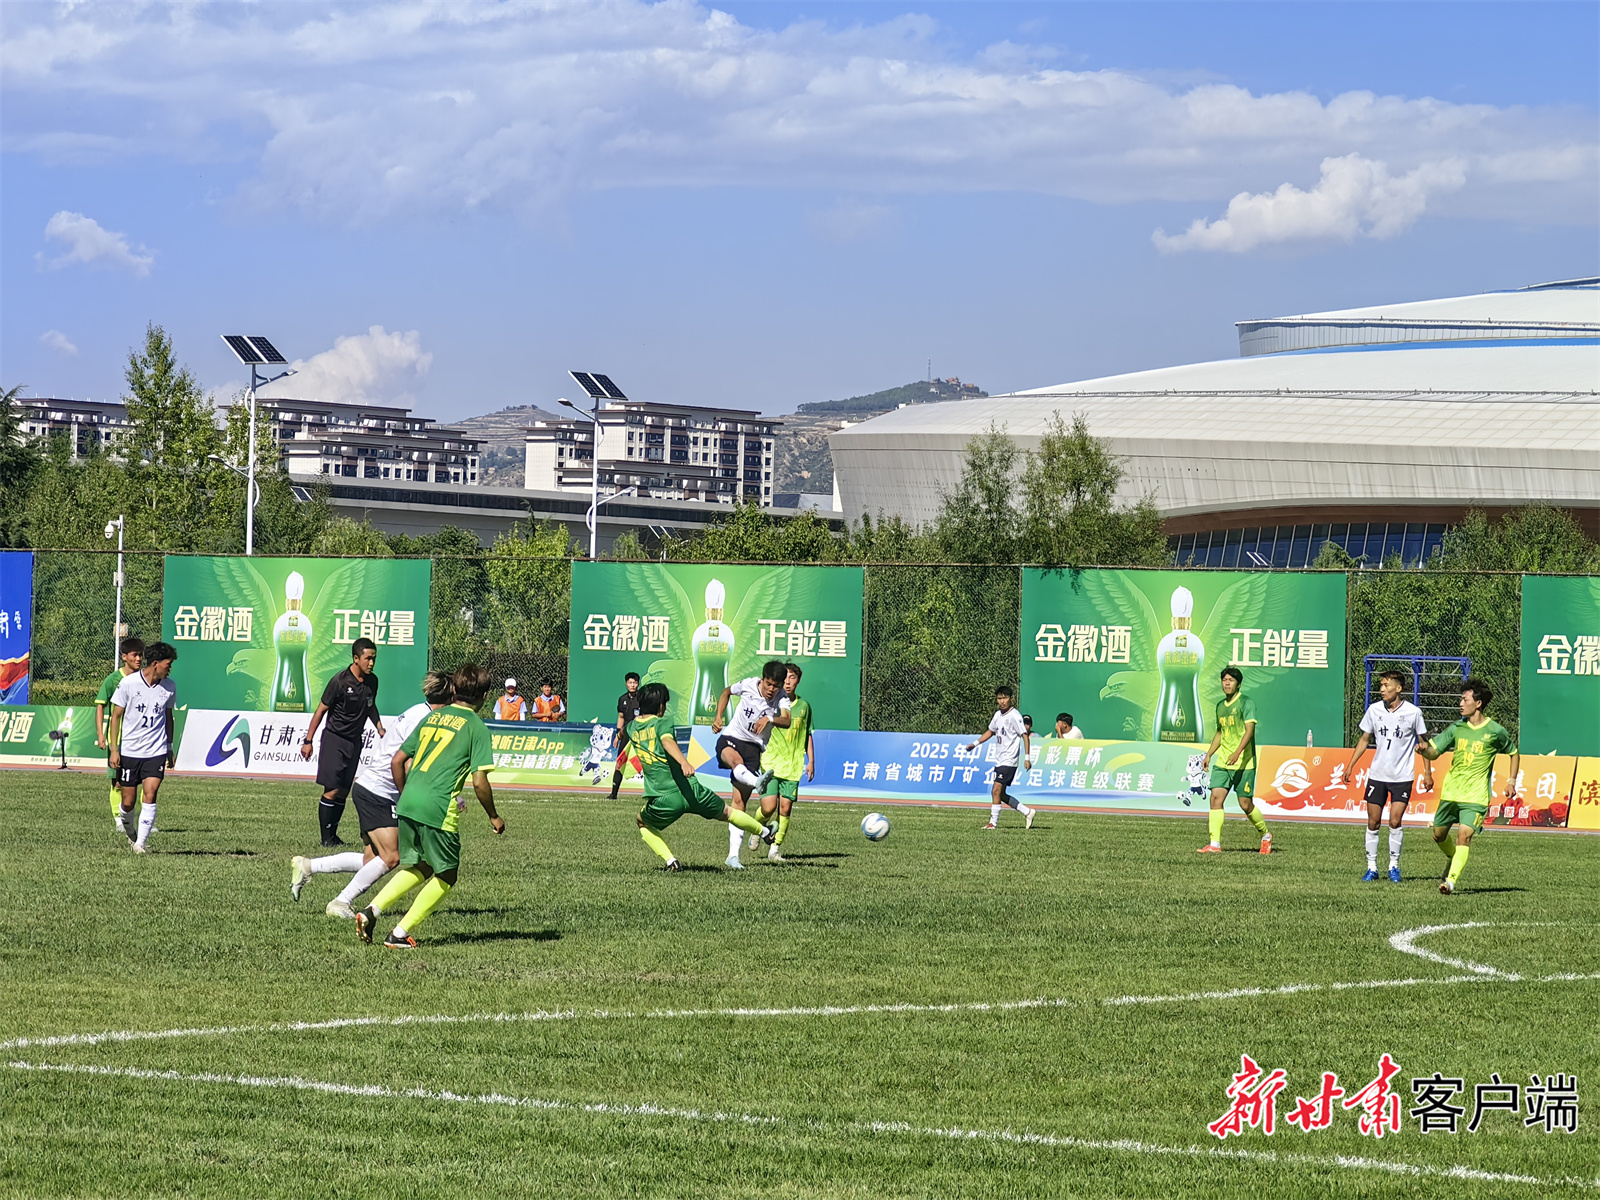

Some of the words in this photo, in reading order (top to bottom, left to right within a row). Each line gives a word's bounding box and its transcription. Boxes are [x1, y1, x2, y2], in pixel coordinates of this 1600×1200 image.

[173, 605, 254, 642] 金徽酒
[332, 609, 416, 646] 正能量
[583, 614, 670, 653] 金徽酒
[756, 619, 848, 658] 正能量
[1035, 624, 1132, 664] 金徽酒
[1228, 628, 1329, 669] 正能量
[141, 715, 155, 728] 21
[1378, 725, 1404, 739] 甘南
[1386, 739, 1392, 750] 7
[1463, 751, 1475, 767] 19
[1243, 781, 1251, 793] 4
[1367, 785, 1376, 797] 7
